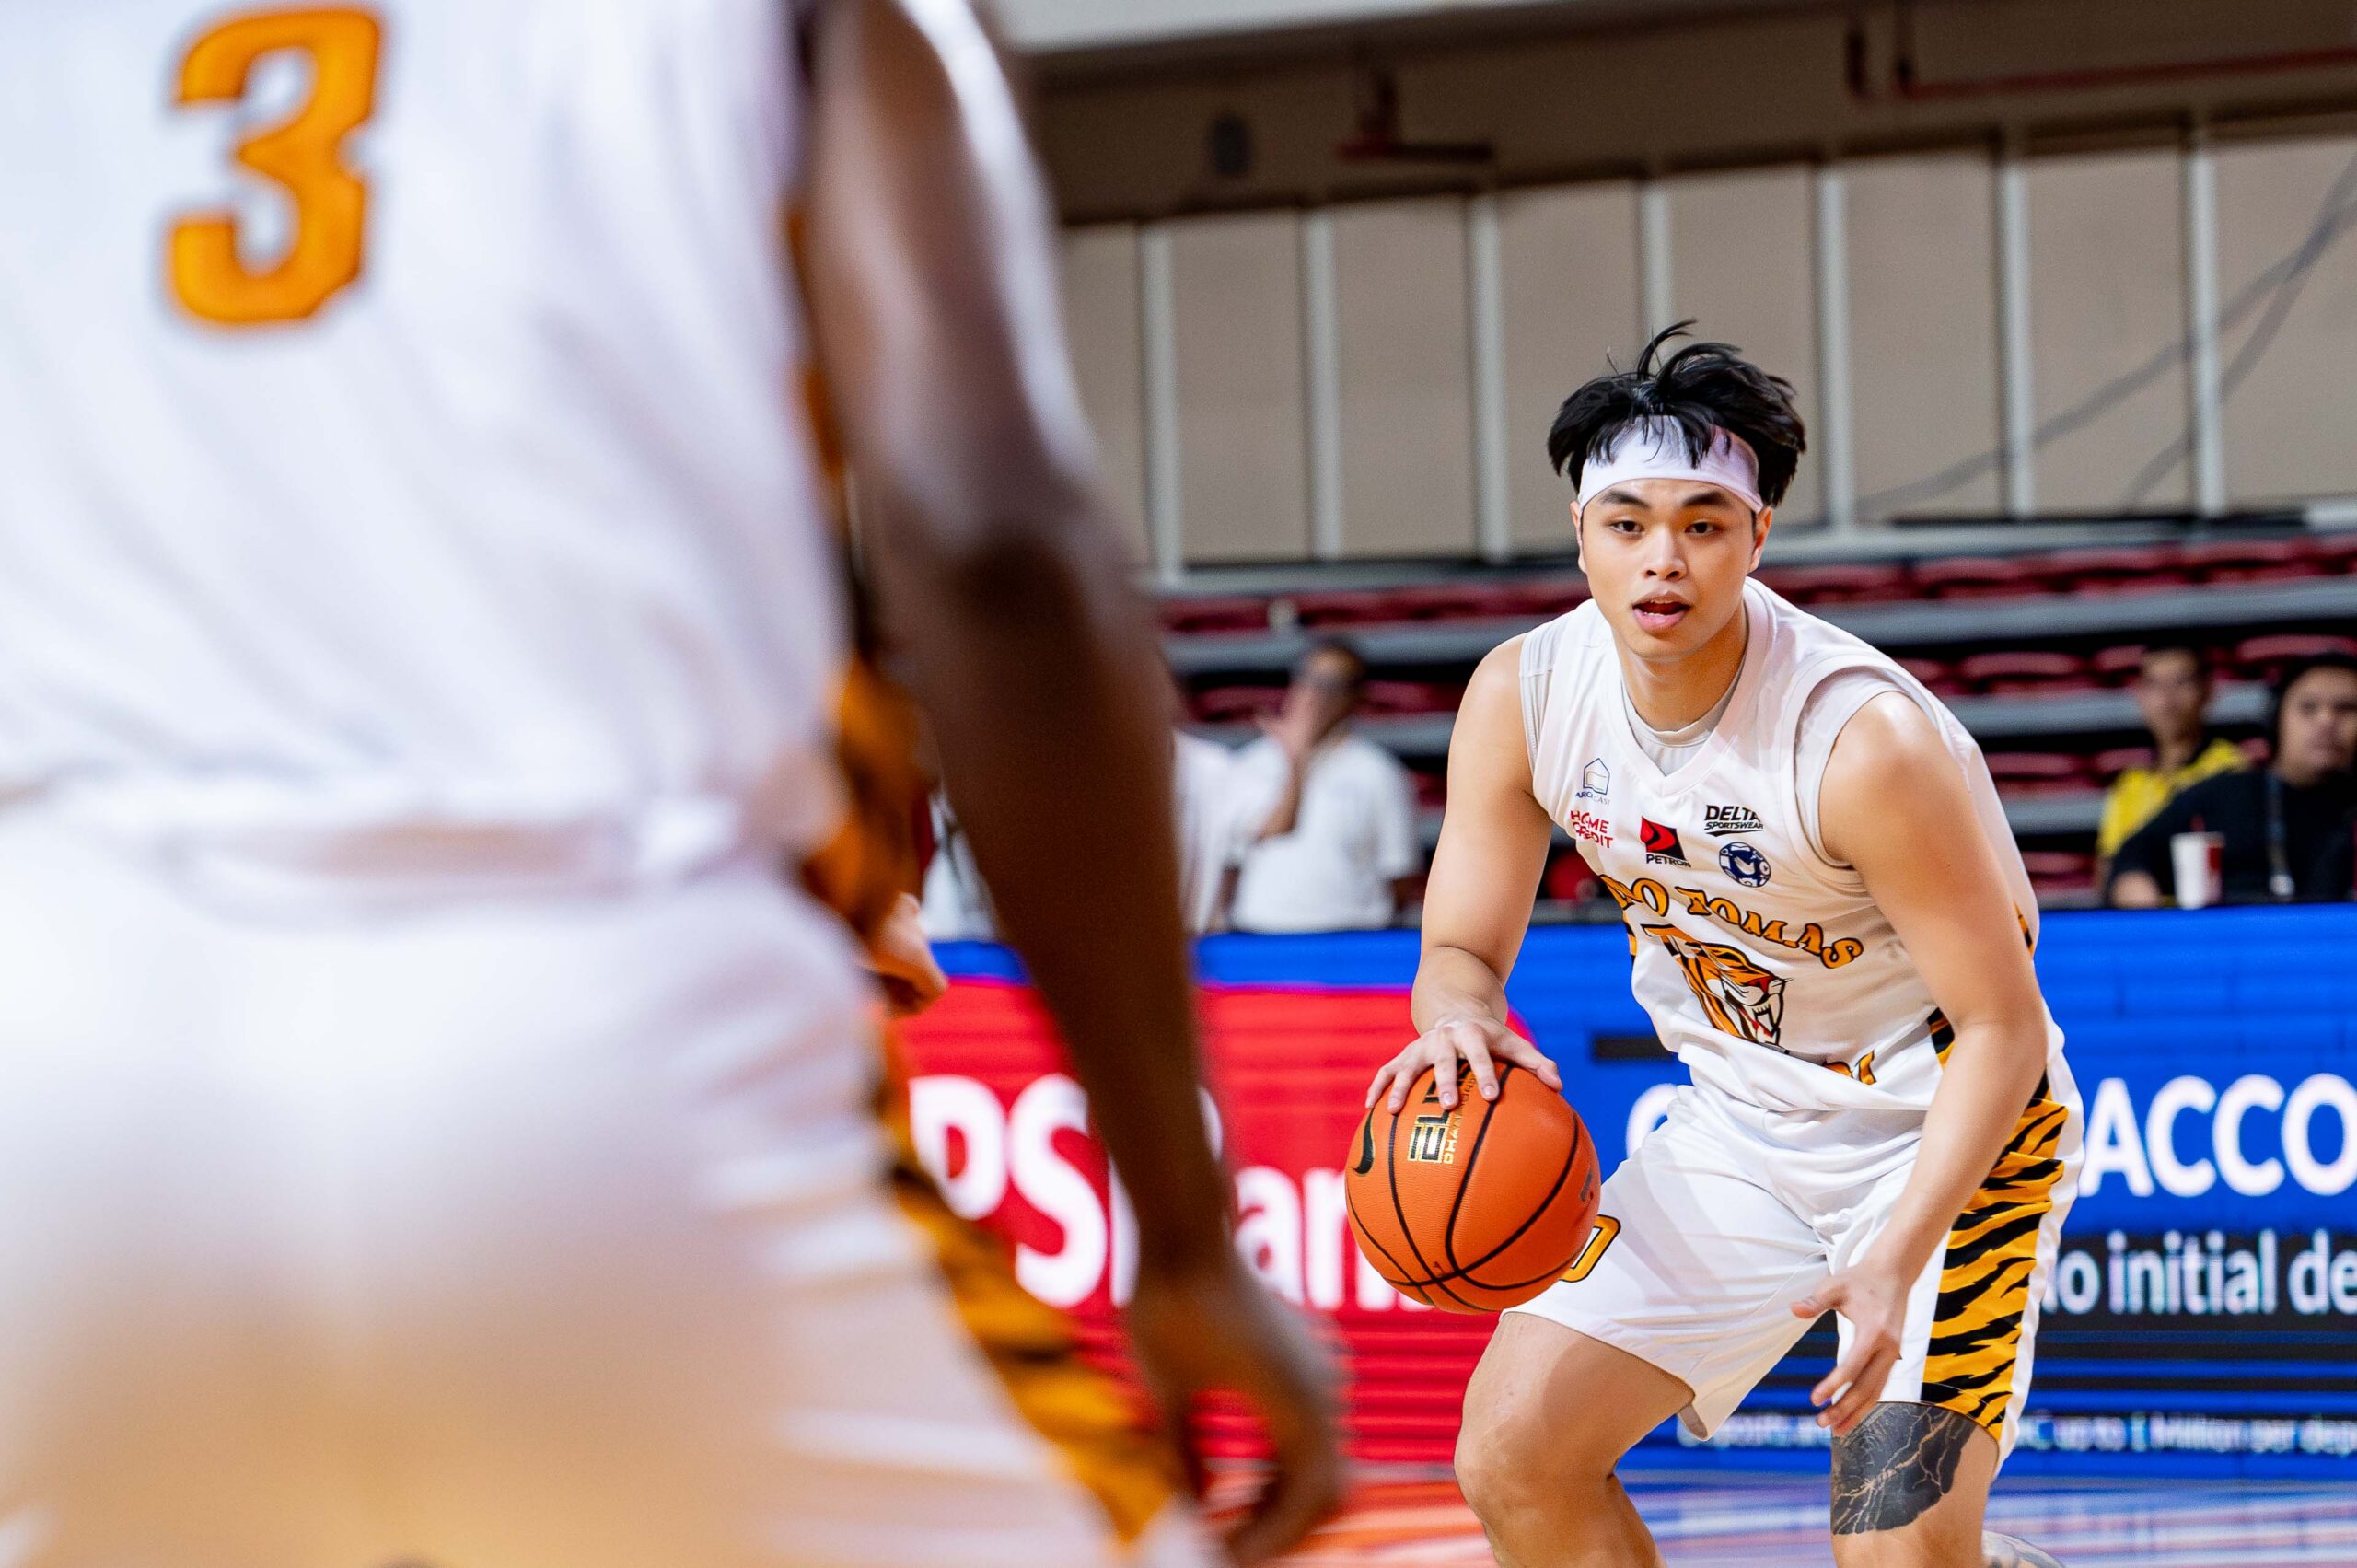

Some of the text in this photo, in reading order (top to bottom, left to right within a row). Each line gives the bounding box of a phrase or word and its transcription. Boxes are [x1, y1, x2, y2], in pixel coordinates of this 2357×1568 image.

[167, 5, 380, 326] 3
[1570, 809, 1609, 834] HOME
[1703, 821, 1764, 830] SPORTSWEAR
[1704, 804, 1761, 823] DELTA
[1573, 821, 1614, 849] CREDIT
[1645, 854, 1692, 868] PETRON
[1674, 885, 1864, 970] TOMAS
[2107, 1228, 2279, 1315] initial
